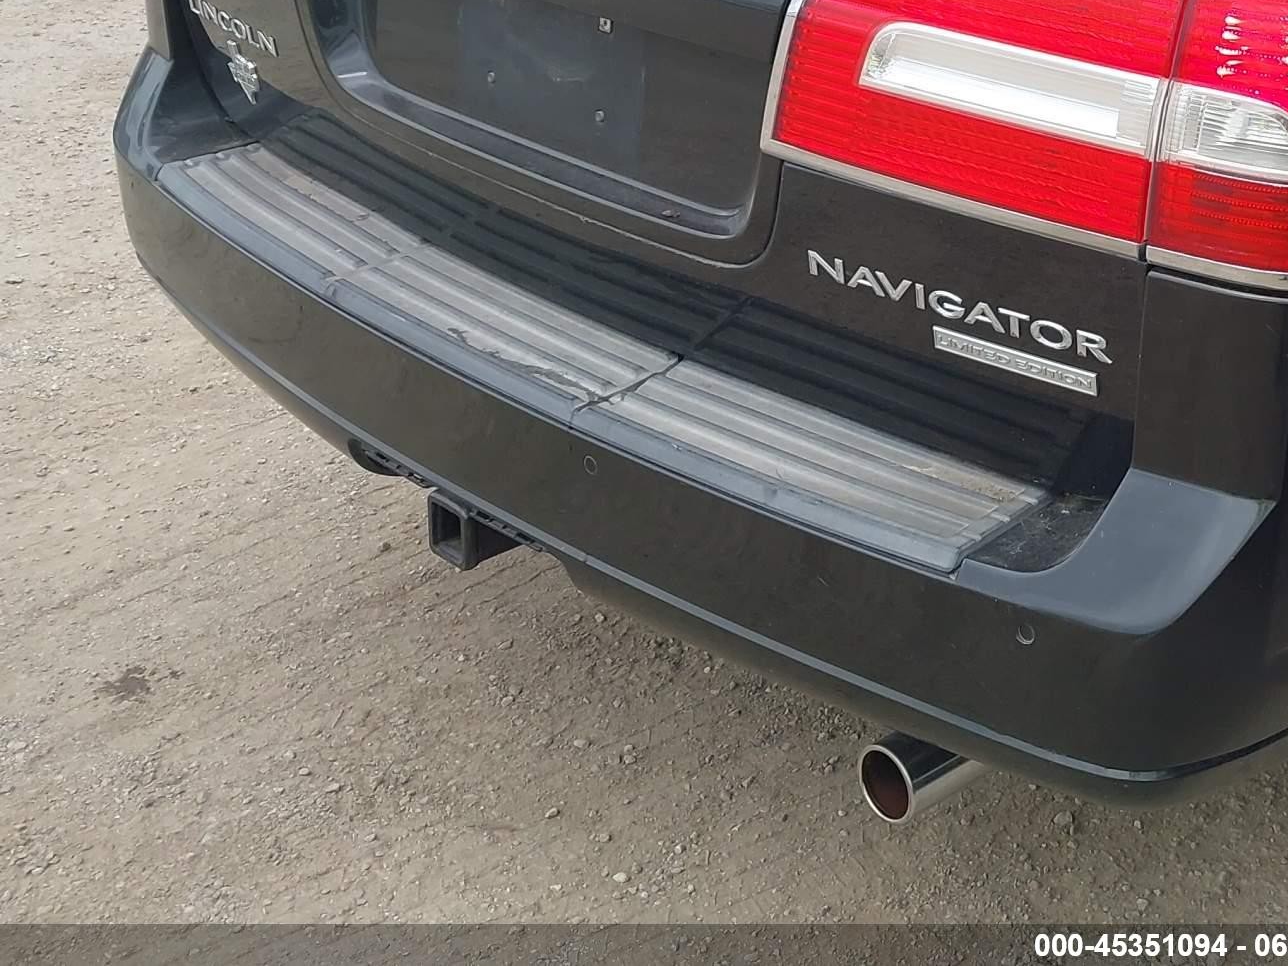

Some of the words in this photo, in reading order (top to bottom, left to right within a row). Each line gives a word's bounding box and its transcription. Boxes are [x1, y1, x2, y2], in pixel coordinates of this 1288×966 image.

[808, 249, 1113, 364] NAVIGATOR
[938, 333, 1011, 367] LIMITED
[1015, 358, 1093, 390] EDITION
